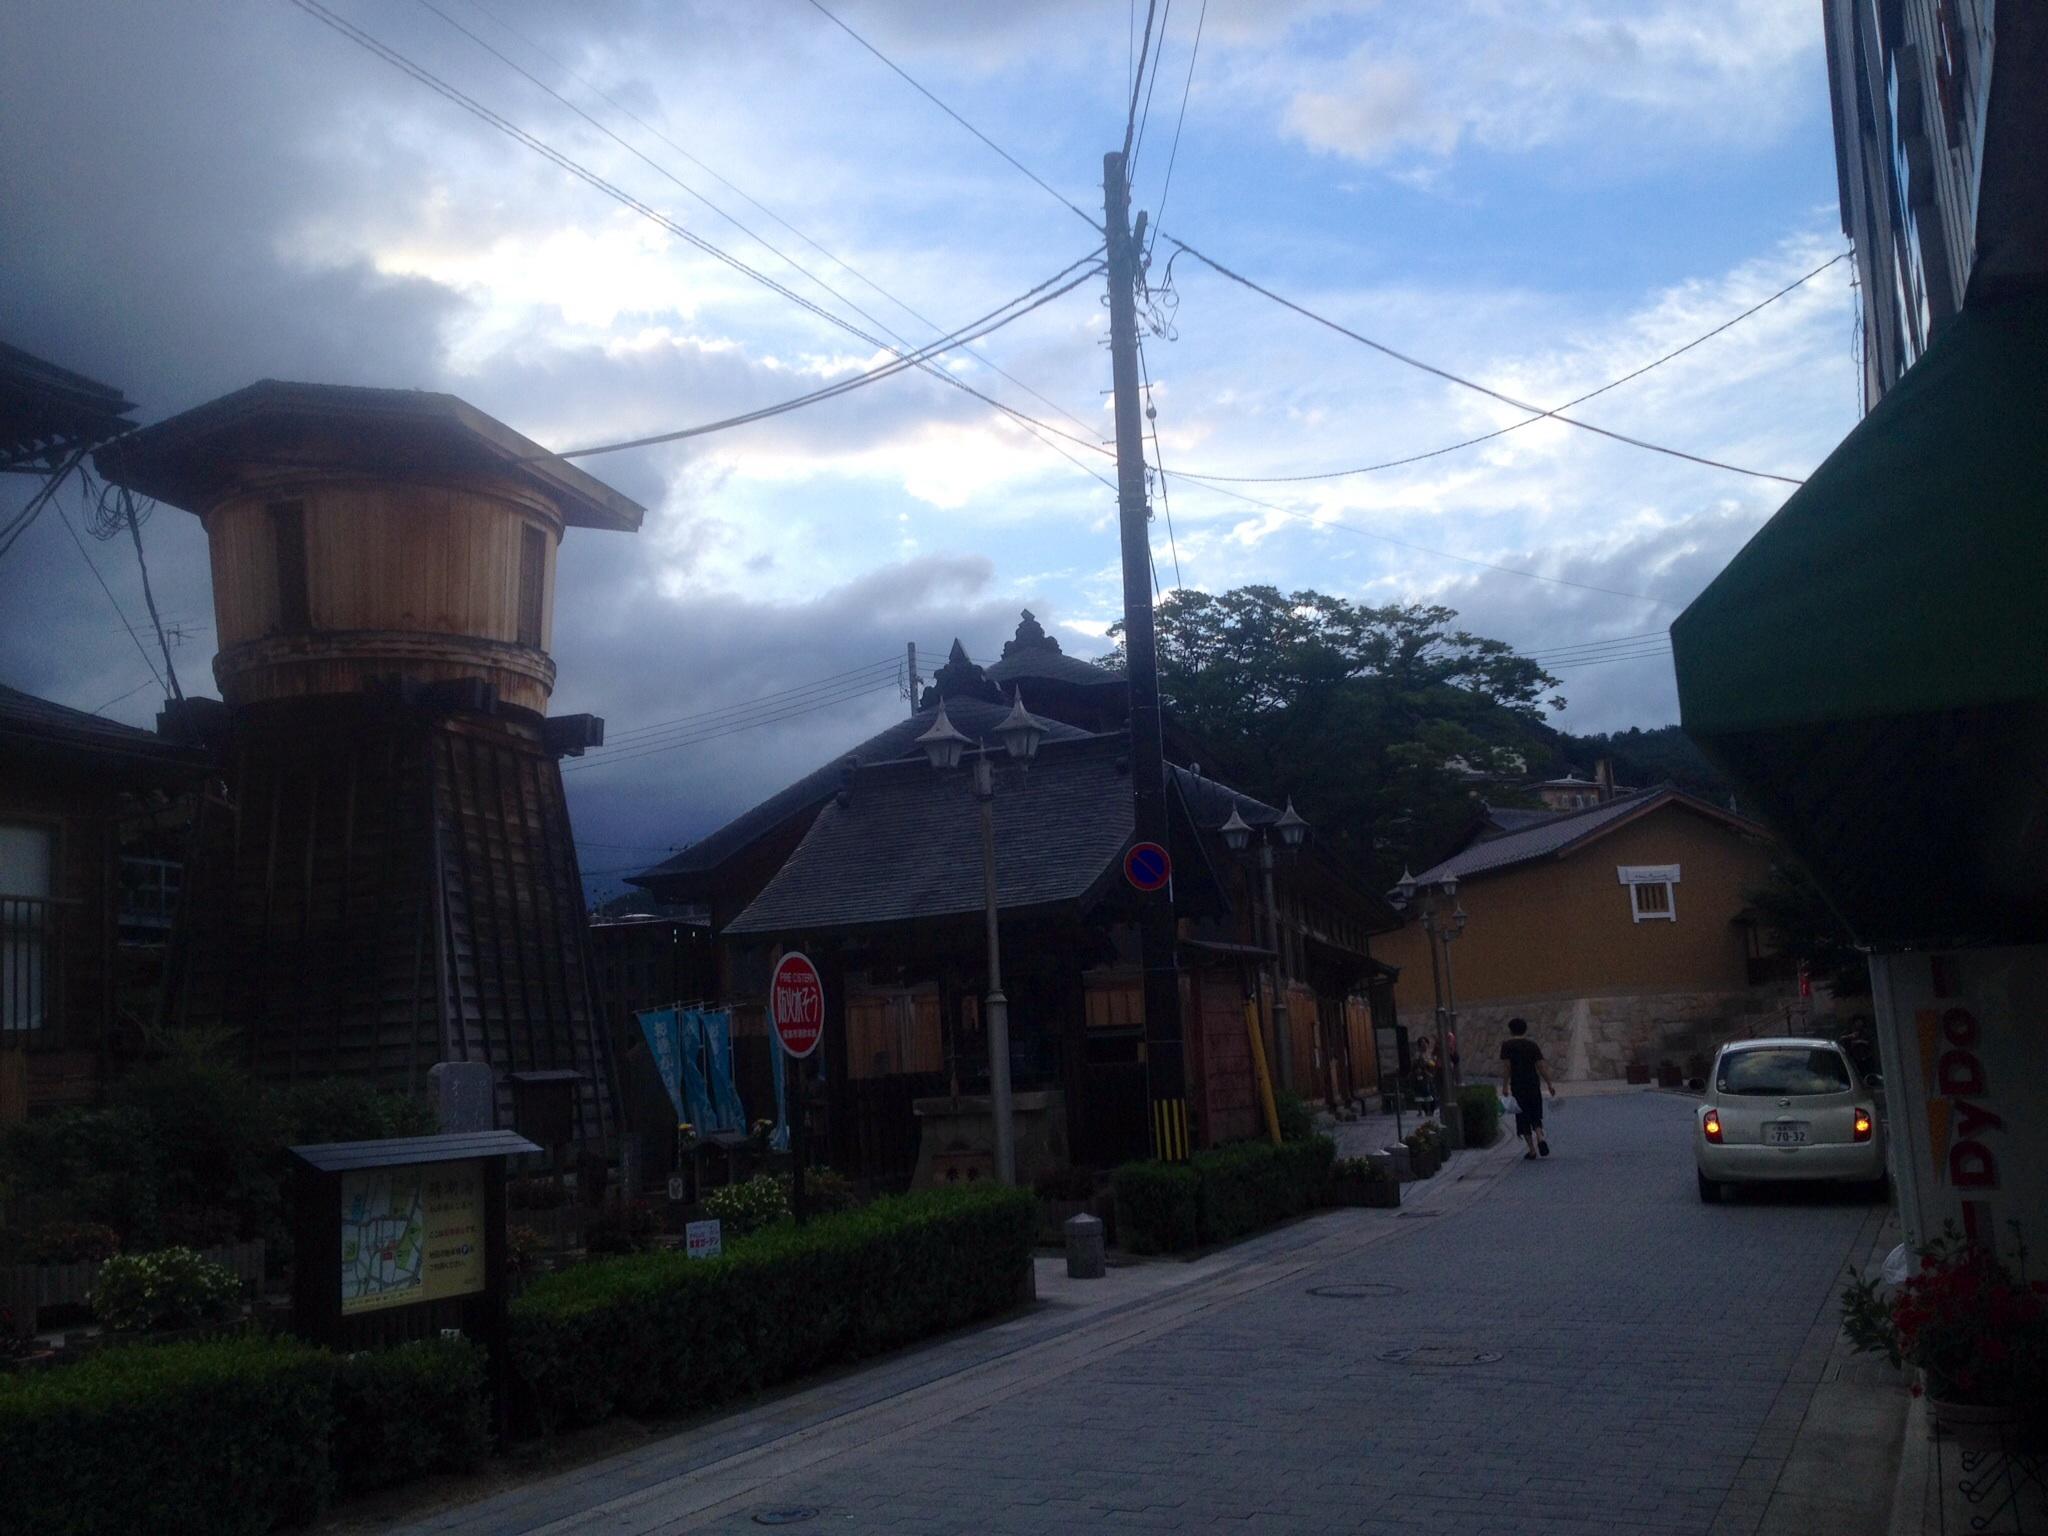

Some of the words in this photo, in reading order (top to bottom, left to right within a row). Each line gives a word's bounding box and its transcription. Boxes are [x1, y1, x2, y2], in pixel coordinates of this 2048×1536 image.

[777, 986, 818, 1023] 防火水そう
[1776, 1131, 1805, 1142] 70-32
